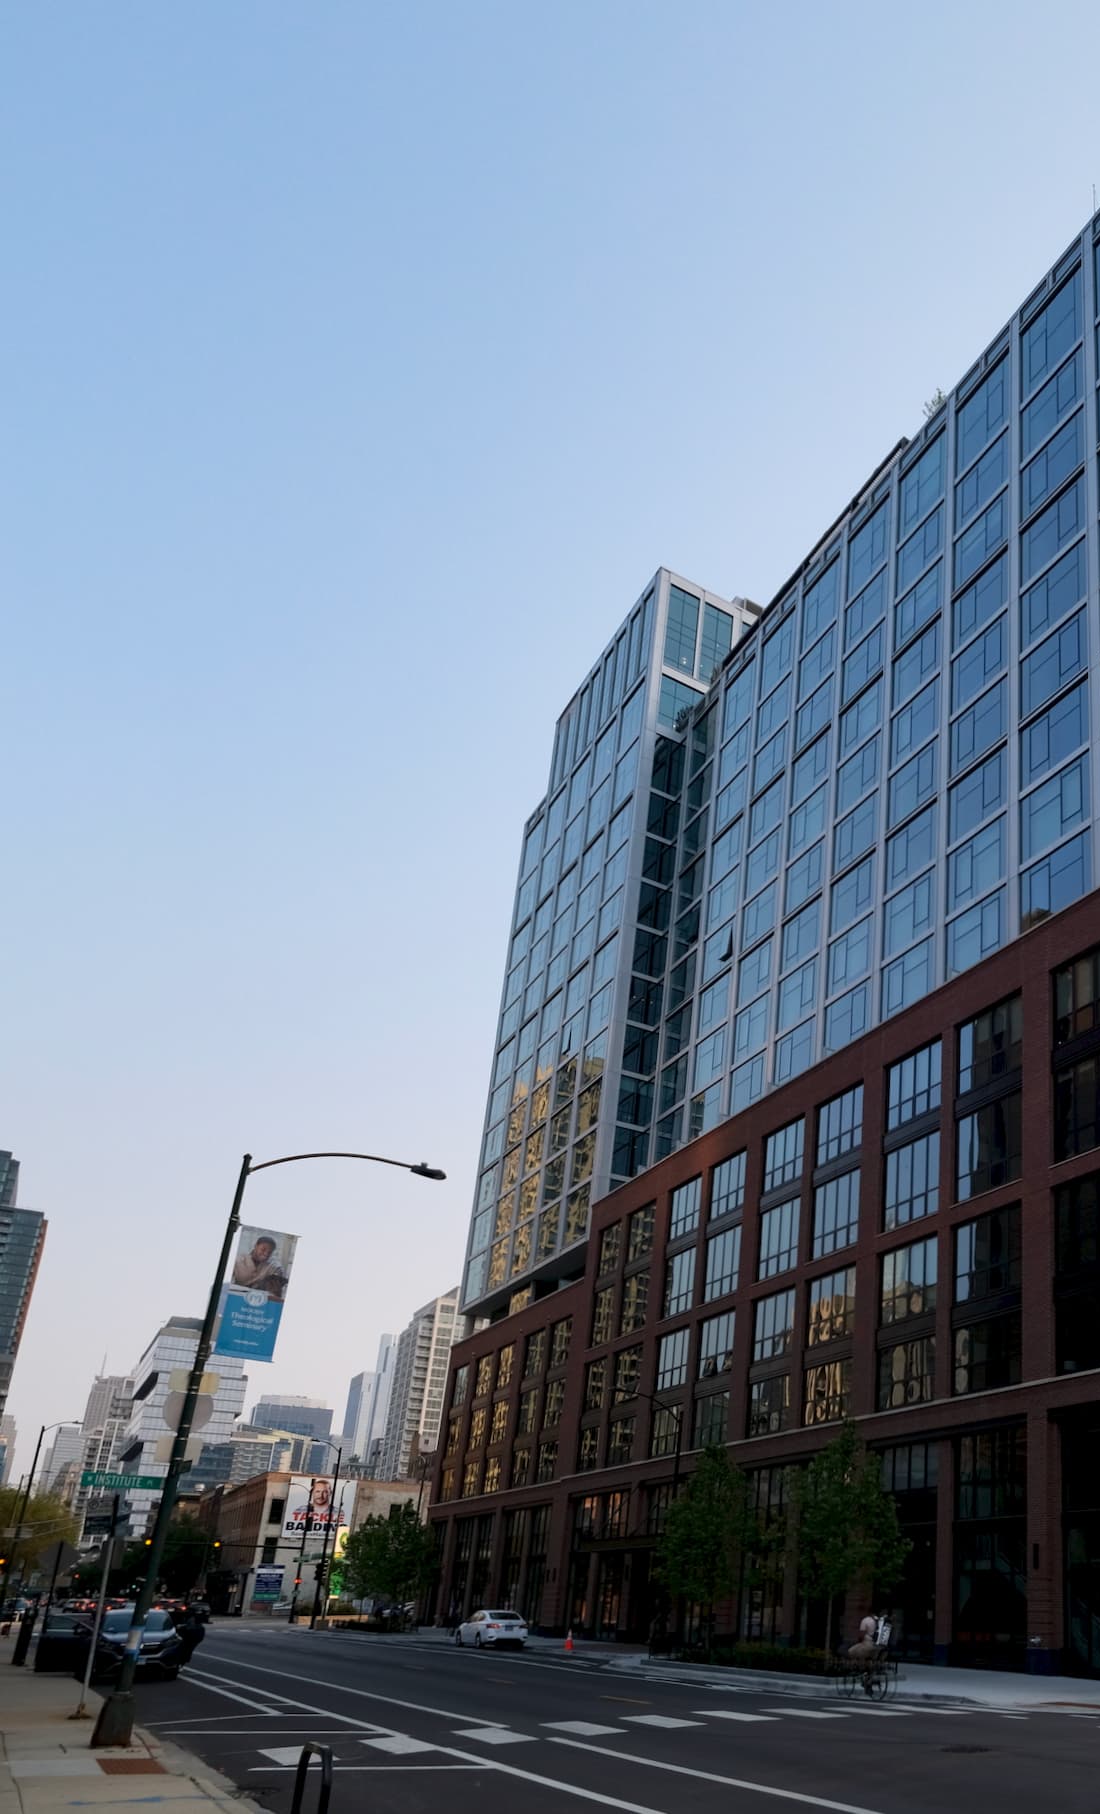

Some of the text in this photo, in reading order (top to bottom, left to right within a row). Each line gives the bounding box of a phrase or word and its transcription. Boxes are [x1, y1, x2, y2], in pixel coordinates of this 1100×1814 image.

[231, 1311, 274, 1325] Theological
[231, 1319, 266, 1333] Seminary
[95, 1474, 143, 1488] INSTITUTE
[291, 1511, 345, 1523] TACKLE
[286, 1521, 348, 1532] BADIN
